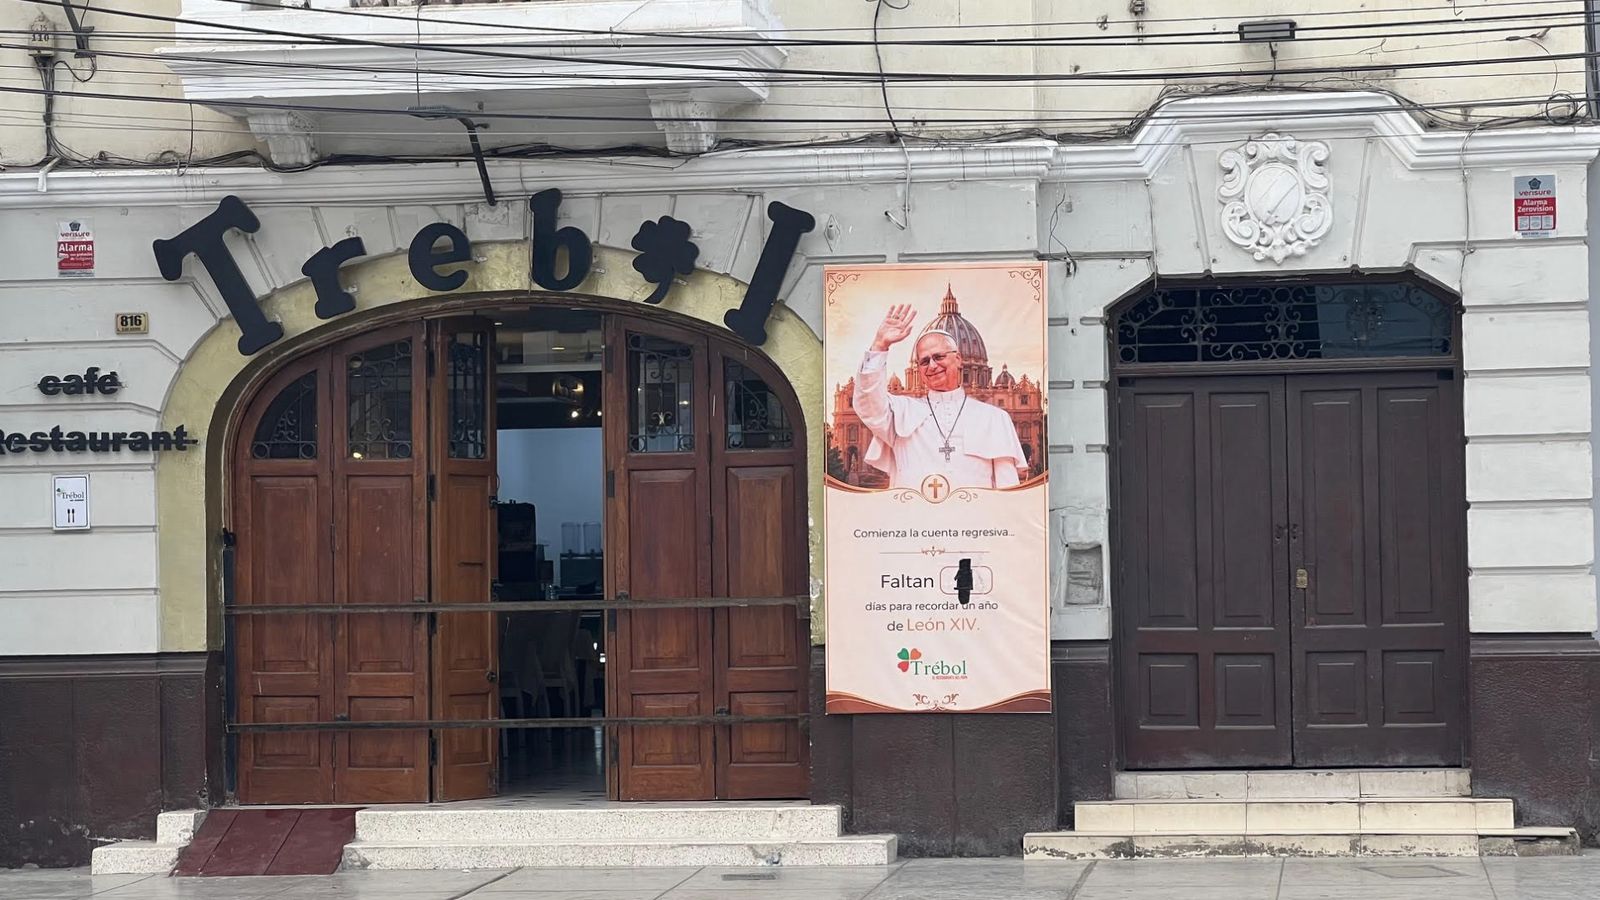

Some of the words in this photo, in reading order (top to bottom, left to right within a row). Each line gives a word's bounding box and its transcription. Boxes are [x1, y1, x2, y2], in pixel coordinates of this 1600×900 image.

[58, 243, 92, 252] Alarma
[120, 315, 142, 327] 816
[0, 424, 190, 455] estaurant
[853, 528, 907, 538] Comienza
[909, 528, 919, 538] la
[921, 528, 959, 538] cuenta
[881, 574, 934, 589] Faltan
[865, 601, 887, 611] días
[889, 603, 912, 612] para
[915, 601, 959, 611] recordar
[961, 602, 976, 610] un
[978, 600, 999, 610] año
[887, 621, 904, 631] de
[907, 617, 945, 632] León
[950, 617, 981, 631] XIV.
[910, 660, 967, 675] Trébol
